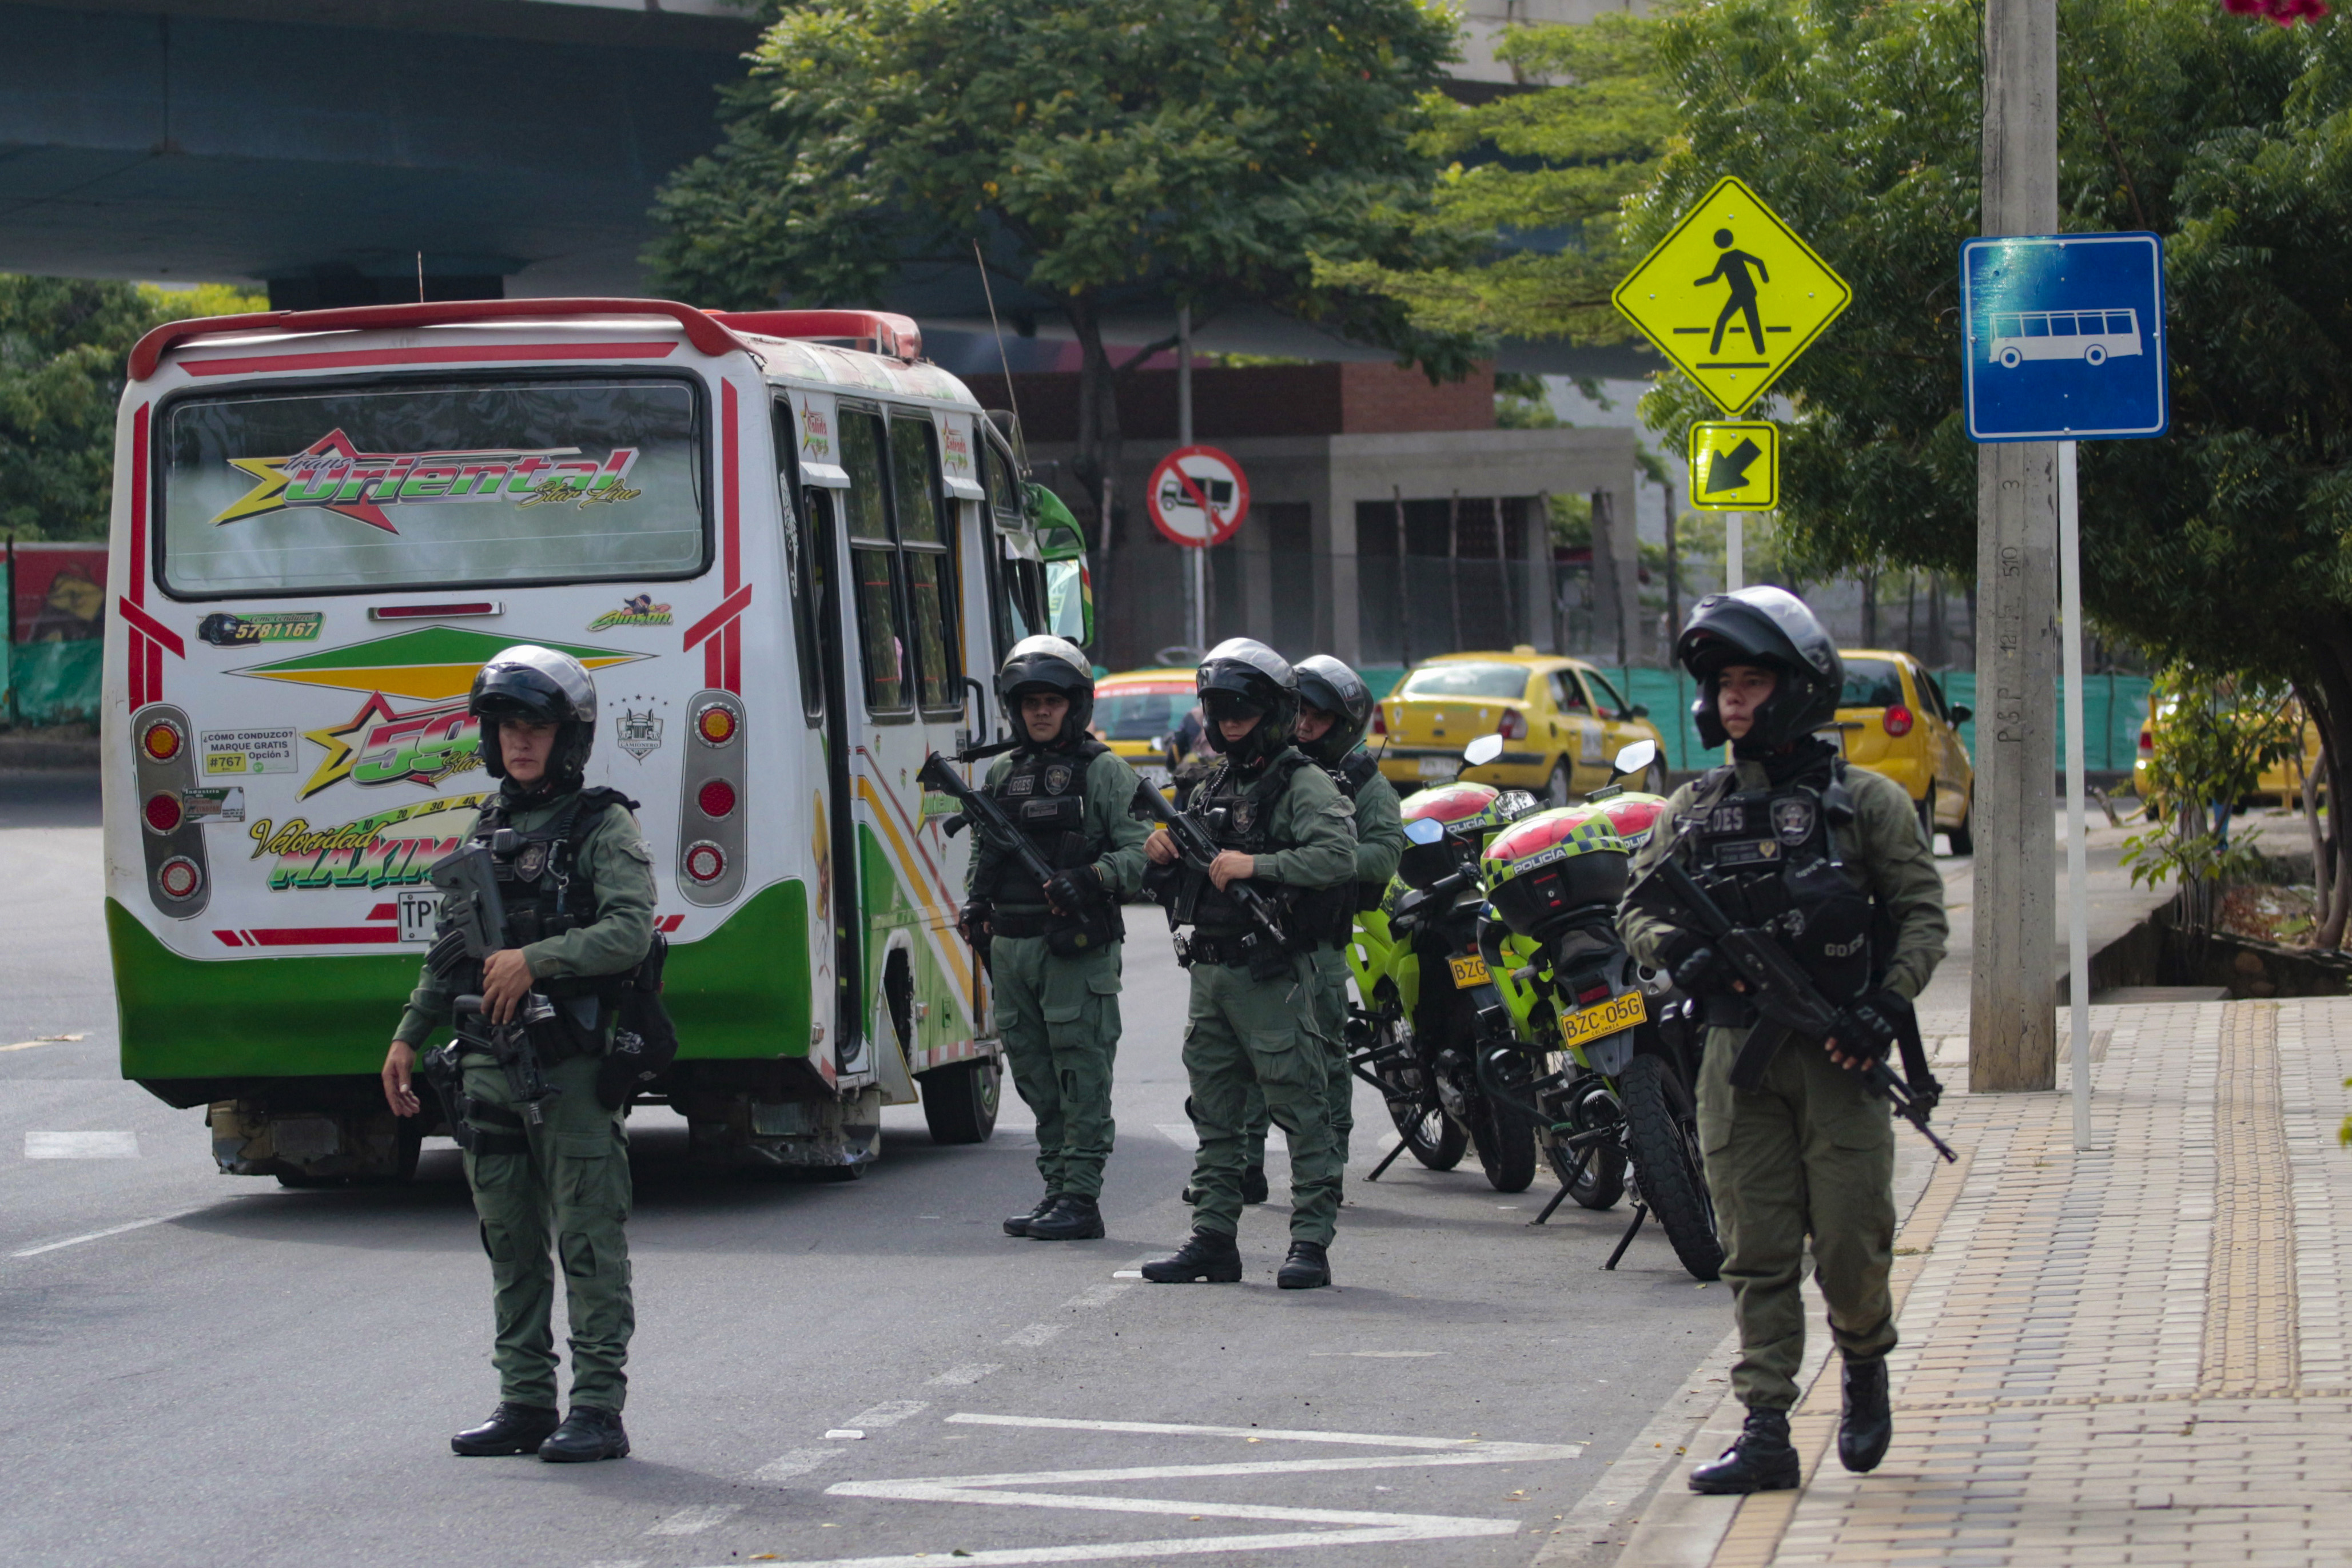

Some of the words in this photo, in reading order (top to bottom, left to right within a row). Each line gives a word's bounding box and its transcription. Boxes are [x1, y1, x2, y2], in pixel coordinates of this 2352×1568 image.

[807, 416, 828, 435] Salida
[946, 435, 966, 454] Entrada
[519, 480, 582, 508] Star
[578, 478, 642, 508] Line
[2002, 480, 2020, 491] 3
[2001, 547, 2020, 577] 510
[235, 622, 318, 639] 5781167
[204, 733, 234, 743] ¿CÓMO
[238, 731, 293, 740] CONDUZCO?
[211, 743, 251, 752] MARQUE
[254, 741, 288, 750] GRATIS
[210, 757, 241, 767] #767
[249, 750, 281, 760] Opción
[429, 751, 486, 782] Star
[1012, 779, 1032, 792] GOES
[362, 819, 372, 831] 10
[397, 810, 408, 819] 20
[429, 801, 444, 811] 30
[462, 796, 476, 805] 40
[249, 818, 390, 859] Velocidad
[1514, 847, 1567, 874] POLICÍA
[1565, 1012, 1600, 1039] BZC
[1606, 998, 1640, 1023] 05G
[1591, 1022, 1620, 1036] COLOMBIA
